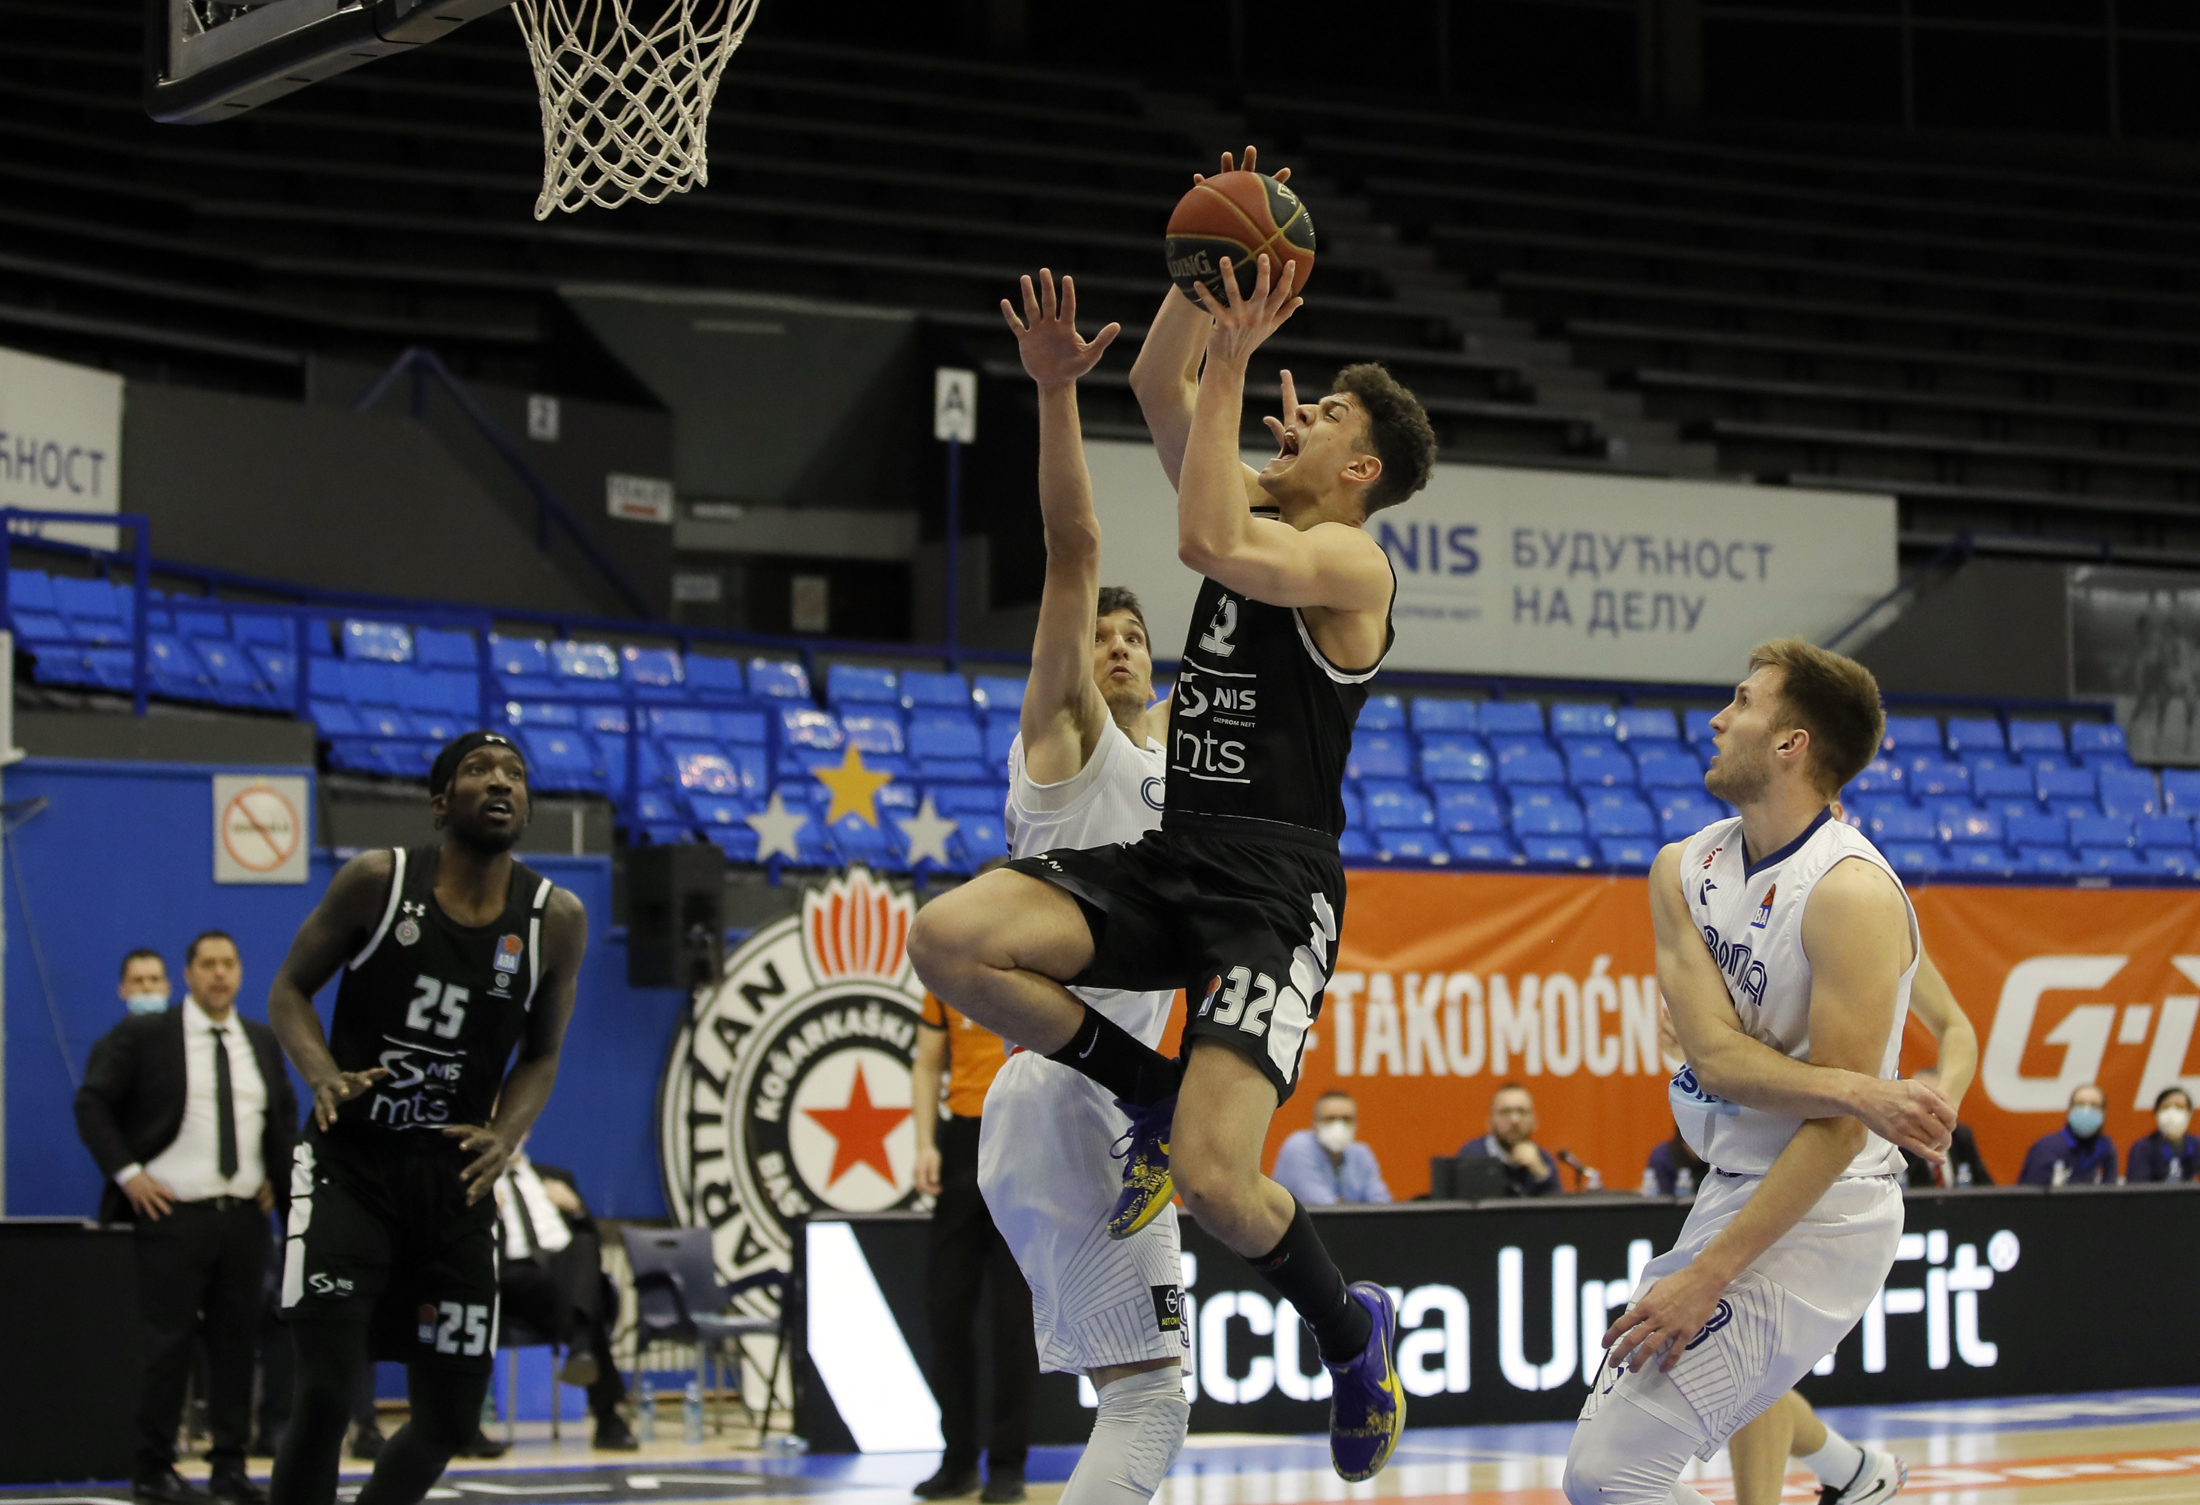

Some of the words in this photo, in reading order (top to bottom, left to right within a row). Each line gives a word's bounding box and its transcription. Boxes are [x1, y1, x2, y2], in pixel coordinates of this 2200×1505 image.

[1378, 521, 1481, 575] NIS
[1511, 527, 1772, 582] БУДУЋНОСТ
[1513, 586, 1572, 626] НА
[1588, 588, 1705, 638] ДЕЛУ
[1212, 687, 1257, 711] NIS
[405, 973, 471, 1039] 25
[1213, 965, 1277, 1038] 32
[426, 1060, 463, 1081] NIS
[370, 1089, 450, 1125] mts
[436, 1301, 489, 1357] 25
